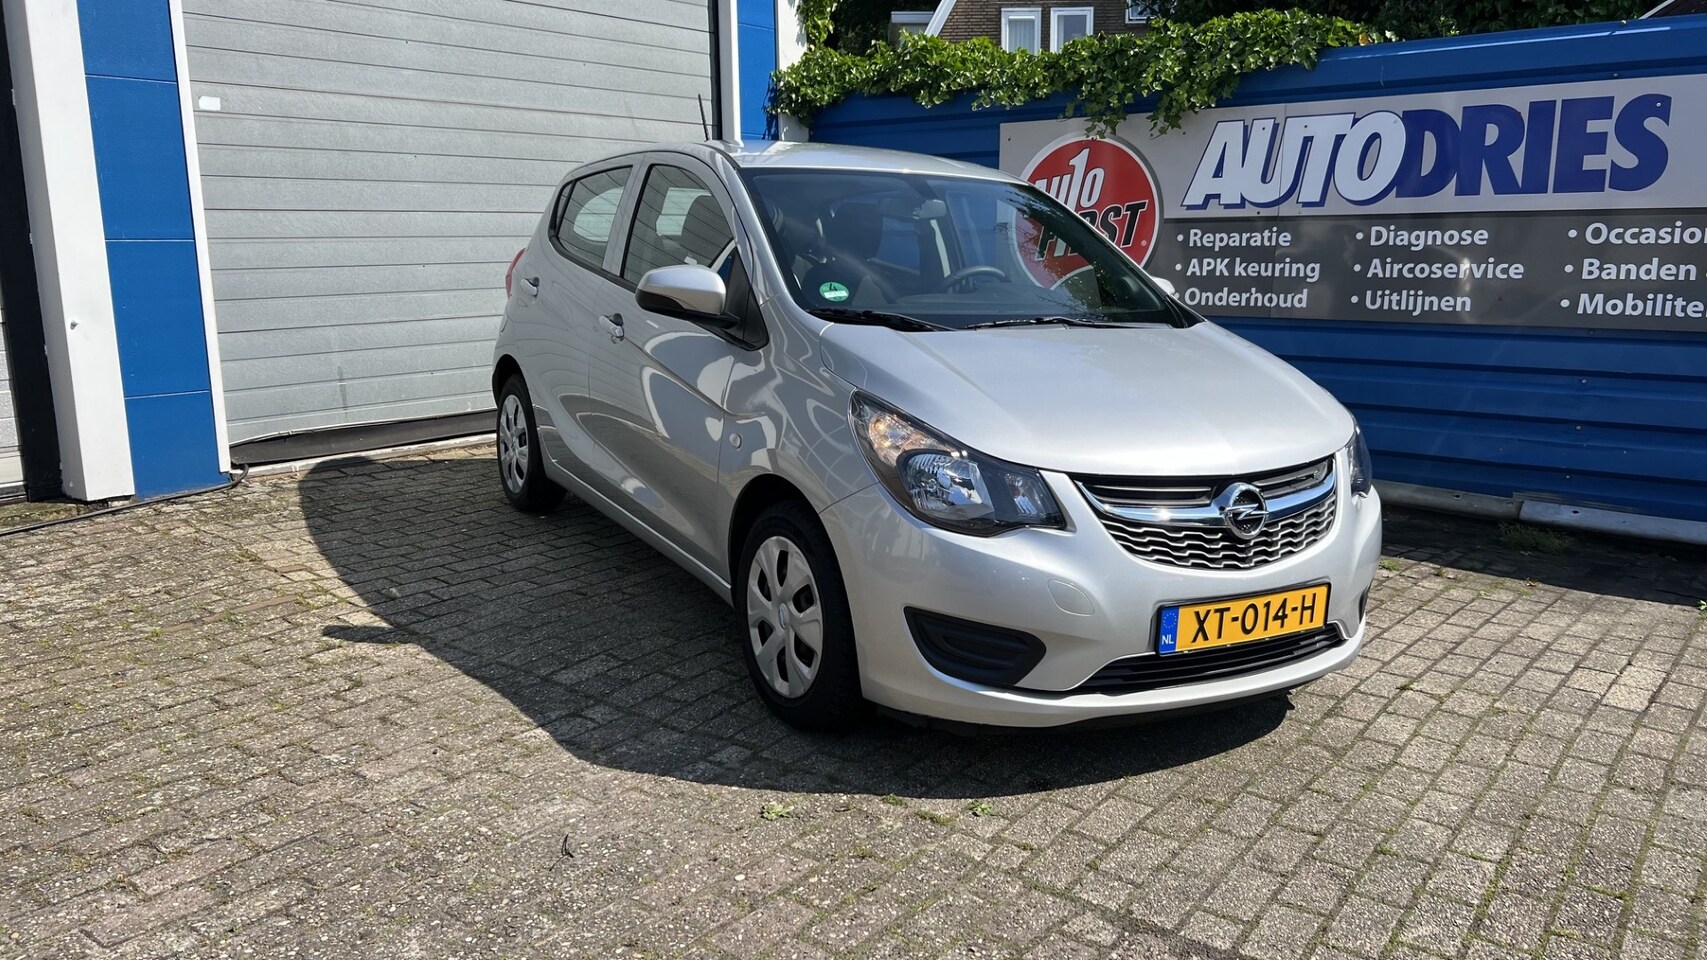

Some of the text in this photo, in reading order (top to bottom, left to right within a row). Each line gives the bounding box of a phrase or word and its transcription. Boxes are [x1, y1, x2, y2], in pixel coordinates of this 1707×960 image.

[1180, 93, 1672, 210] AUTODRIES
[1188, 226, 1291, 252] Reparatie
[1370, 225, 1489, 251] Diagnose
[1585, 220, 1707, 244] Occasio
[1186, 257, 1320, 283] APK keuring
[1366, 257, 1525, 279] Aircoservice
[1582, 257, 1697, 280] Banden
[1184, 287, 1308, 308] Onderhoud
[1365, 289, 1471, 316] Uitlijnen
[1577, 293, 1707, 318] Mobilite
[1161, 593, 1317, 645] NL XT-014-H
